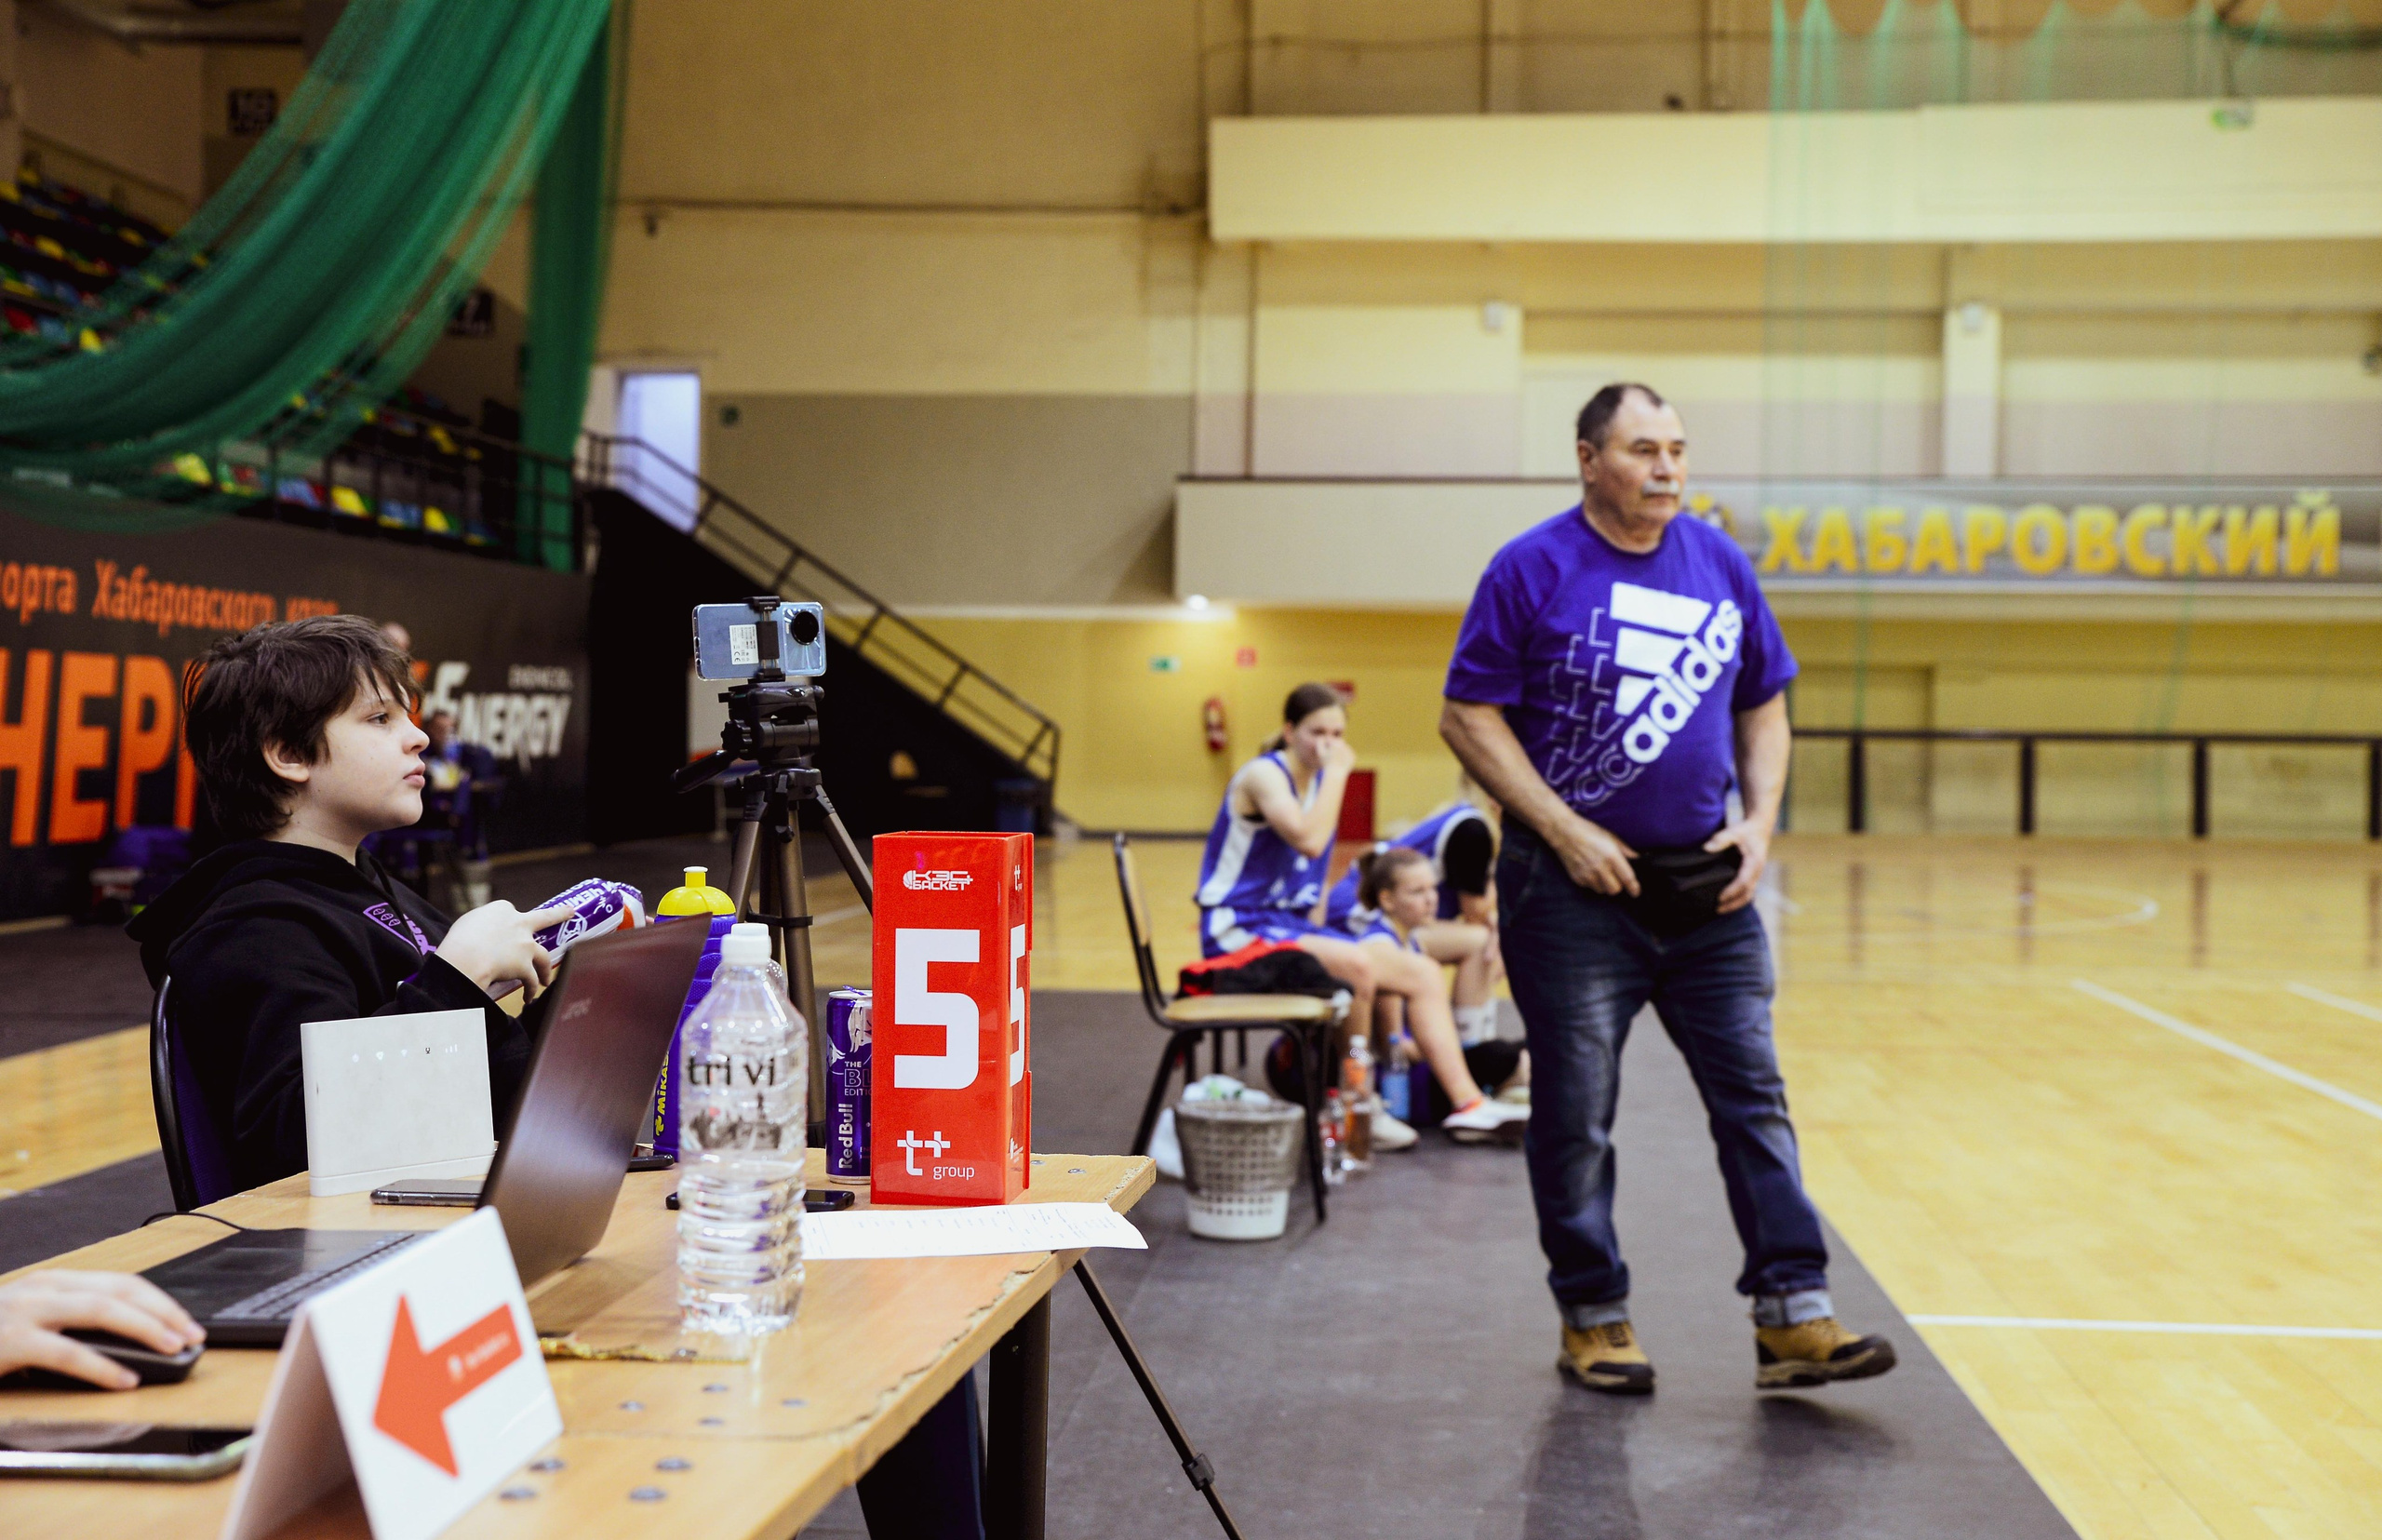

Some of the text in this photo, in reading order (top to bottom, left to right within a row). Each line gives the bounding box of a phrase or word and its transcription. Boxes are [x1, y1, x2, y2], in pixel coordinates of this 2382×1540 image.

[1761, 489, 2340, 575] ХАБАРОВСКИЙ
[0, 561, 77, 625] орта
[92, 558, 276, 638] Хабаровского
[1623, 599, 1743, 764] adidas
[913, 880, 966, 891] БАСКЕТ
[894, 928, 980, 1090] 5
[1010, 923, 1025, 1087] 5
[688, 1056, 731, 1086] tri
[844, 1068, 872, 1088] BL
[932, 1166, 975, 1181] group
